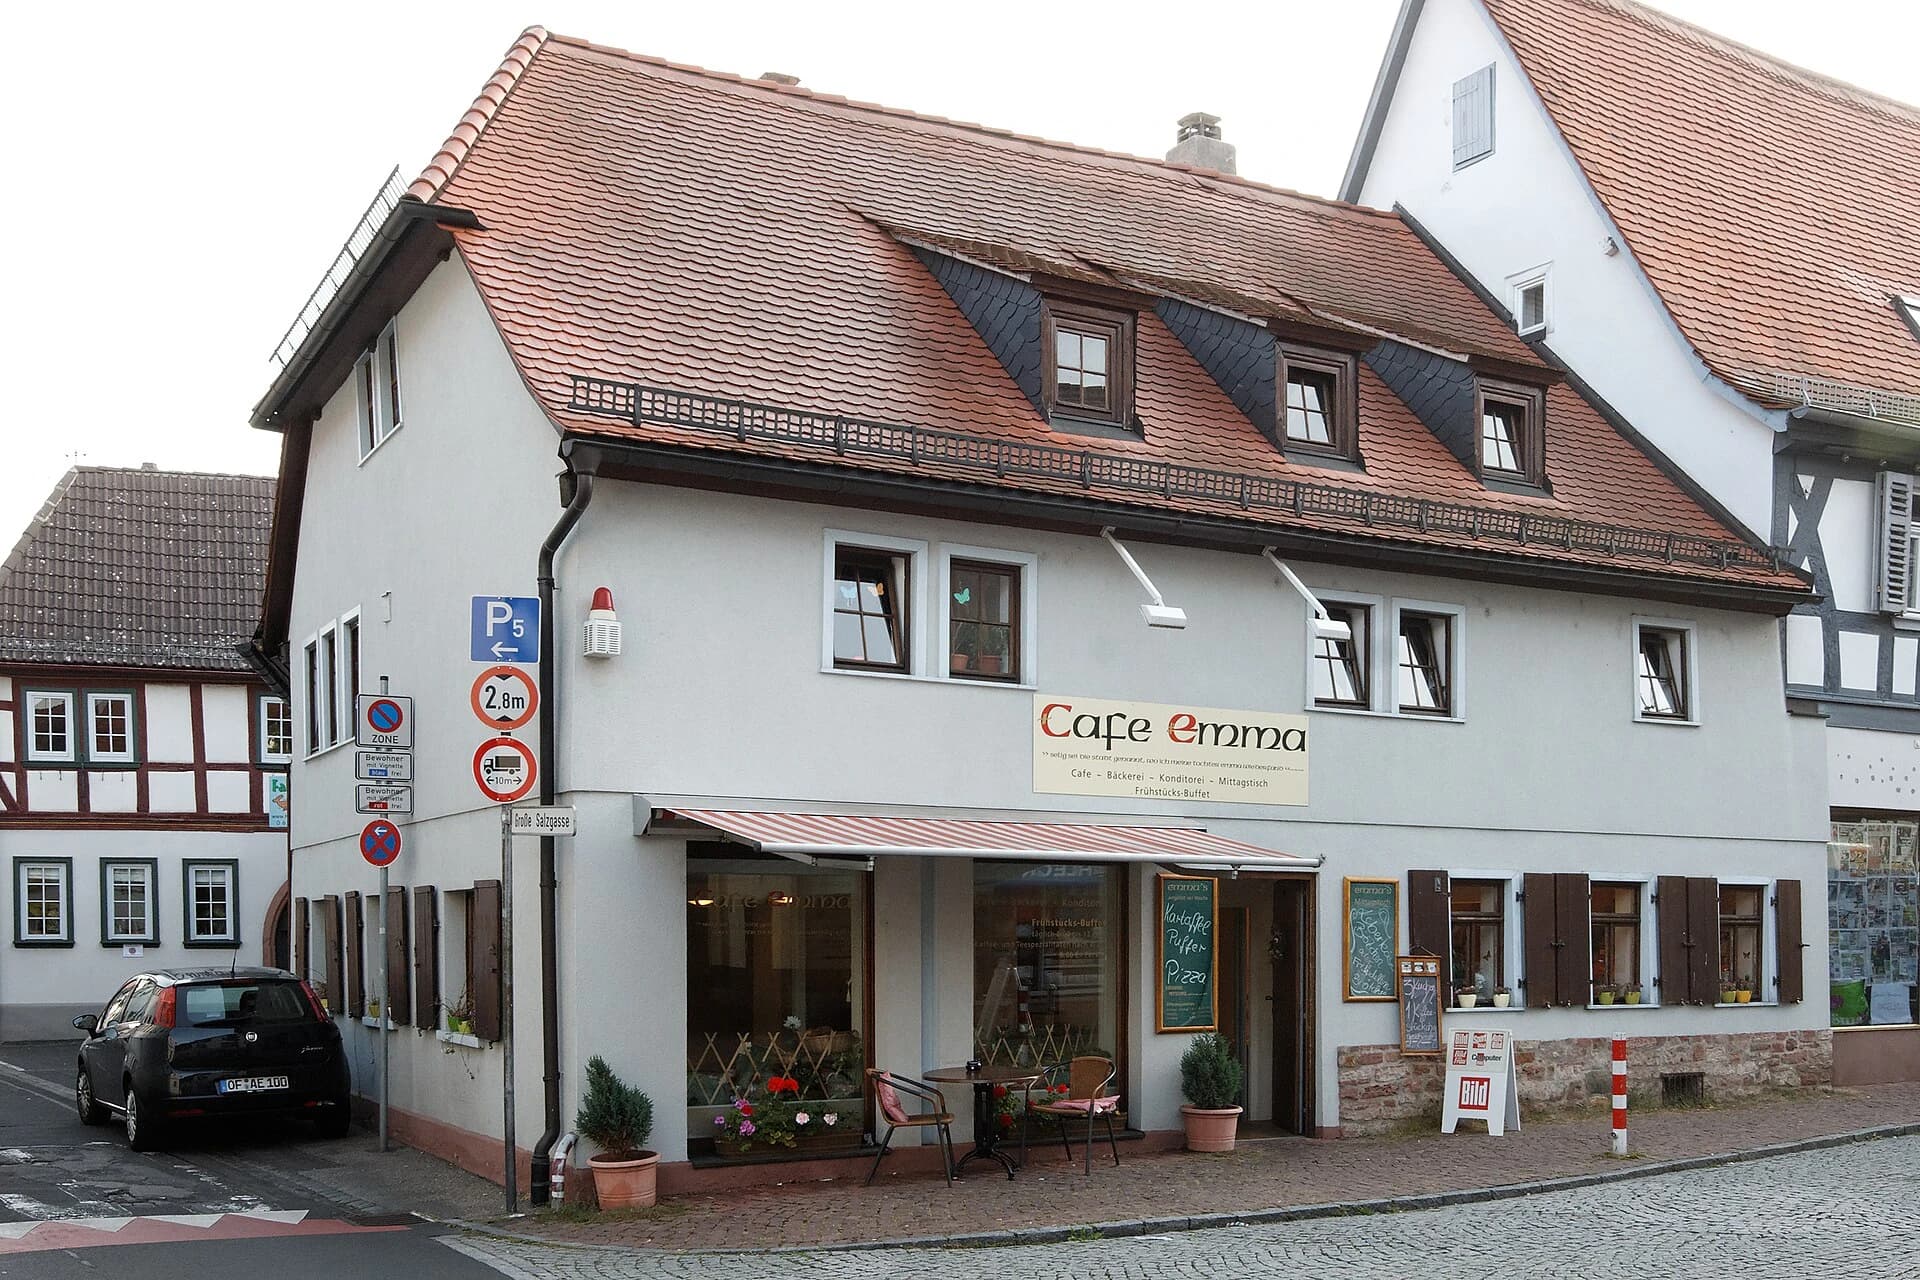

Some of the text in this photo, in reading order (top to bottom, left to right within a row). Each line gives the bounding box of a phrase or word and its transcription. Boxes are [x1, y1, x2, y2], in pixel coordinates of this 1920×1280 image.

[1038, 703, 1152, 751] Cafe
[372, 734, 399, 744] ZONE
[365, 754, 404, 762] Bewohner
[494, 776, 514, 786] 10m
[1071, 768, 1092, 779] Cafe
[1106, 770, 1145, 782] Bäckerei
[1159, 773, 1205, 785] Konditorei
[1218, 776, 1269, 789] Mittagstisch
[365, 787, 404, 795] Bewohner
[1135, 786, 1211, 799] Frühstücks-Buffet
[535, 811, 570, 831] Salzgasse
[1164, 902, 1211, 936] Kartoffel
[1165, 959, 1206, 985] Pizza
[227, 1077, 288, 1090] OF AE 100
[1461, 1079, 1488, 1107] Bild
